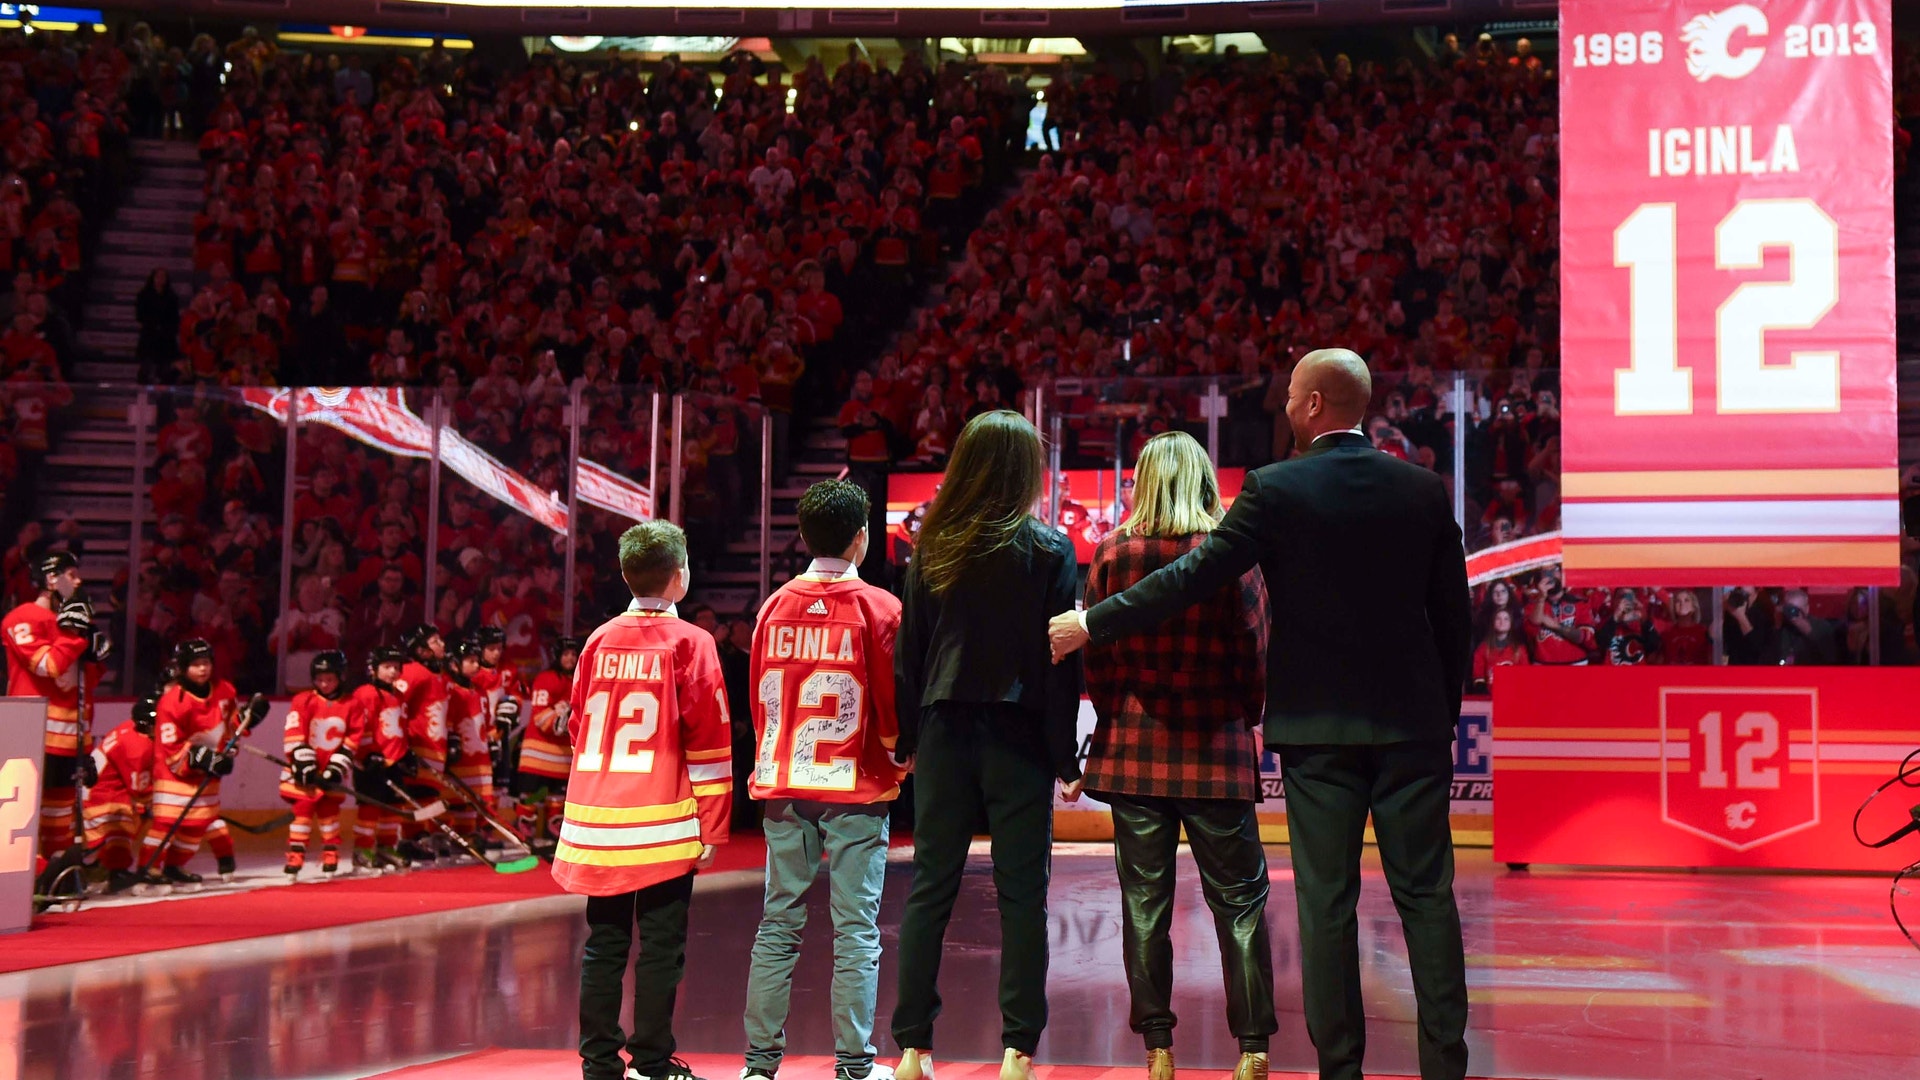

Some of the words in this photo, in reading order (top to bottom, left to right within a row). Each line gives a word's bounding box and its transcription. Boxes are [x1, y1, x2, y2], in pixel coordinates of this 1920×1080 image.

[1572, 30, 1664, 67] 1996
[1785, 21, 1877, 59] 2013
[1648, 124, 1799, 177] IGINLA
[1612, 198, 1841, 416] 12
[595, 652, 662, 680] IGINLA
[766, 624, 854, 661] IGINLA
[576, 691, 660, 773] 12
[755, 669, 864, 791] 12
[1697, 710, 1781, 790] 12
